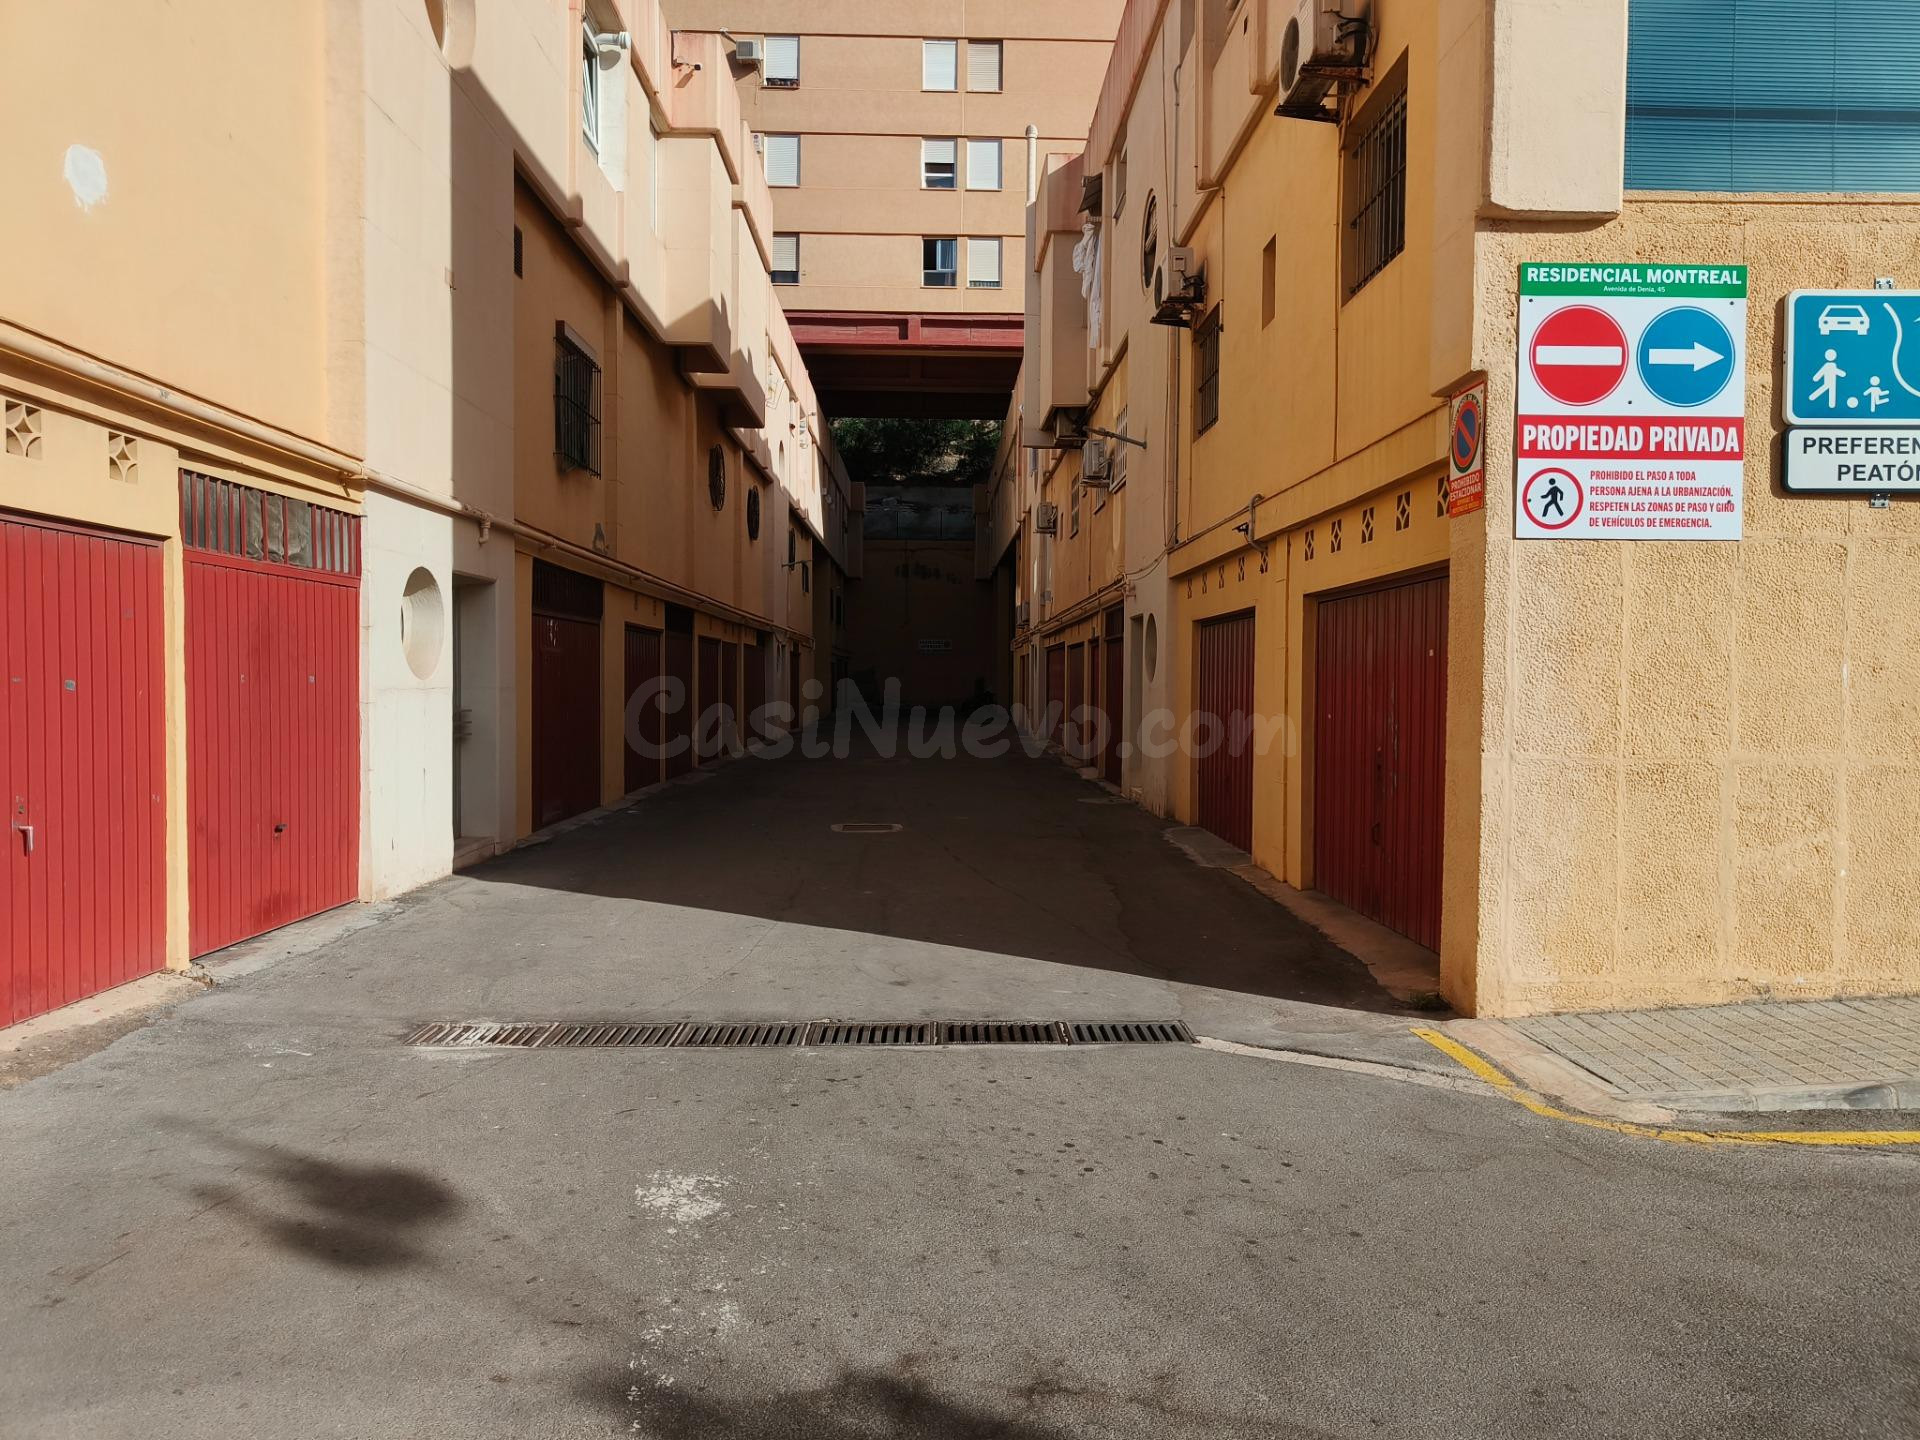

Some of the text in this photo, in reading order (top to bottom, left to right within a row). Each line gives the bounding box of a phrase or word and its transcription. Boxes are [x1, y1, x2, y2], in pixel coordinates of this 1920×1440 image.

[1527, 267, 1742, 285] RESIDENCIAL MONTREAL
[1522, 425, 1740, 453] PROPIEDAD PRIVADA
[1803, 437, 1920, 455] PREFEREN
[1451, 473, 1480, 491] PROHIBIDO
[1590, 470, 1696, 481] PROHIBIDO EL PASO A TODA
[1450, 483, 1482, 501] ESTACIONAR
[1589, 484, 1734, 497] PERSONA AJENA A LA URBANIZACIÓN.
[1589, 502, 1735, 513] RESPETEN LAS ZONAS DE PASO Y GIRO
[1589, 515, 1713, 528] DE VEHÍCULOS DE EMERGENCIA.
